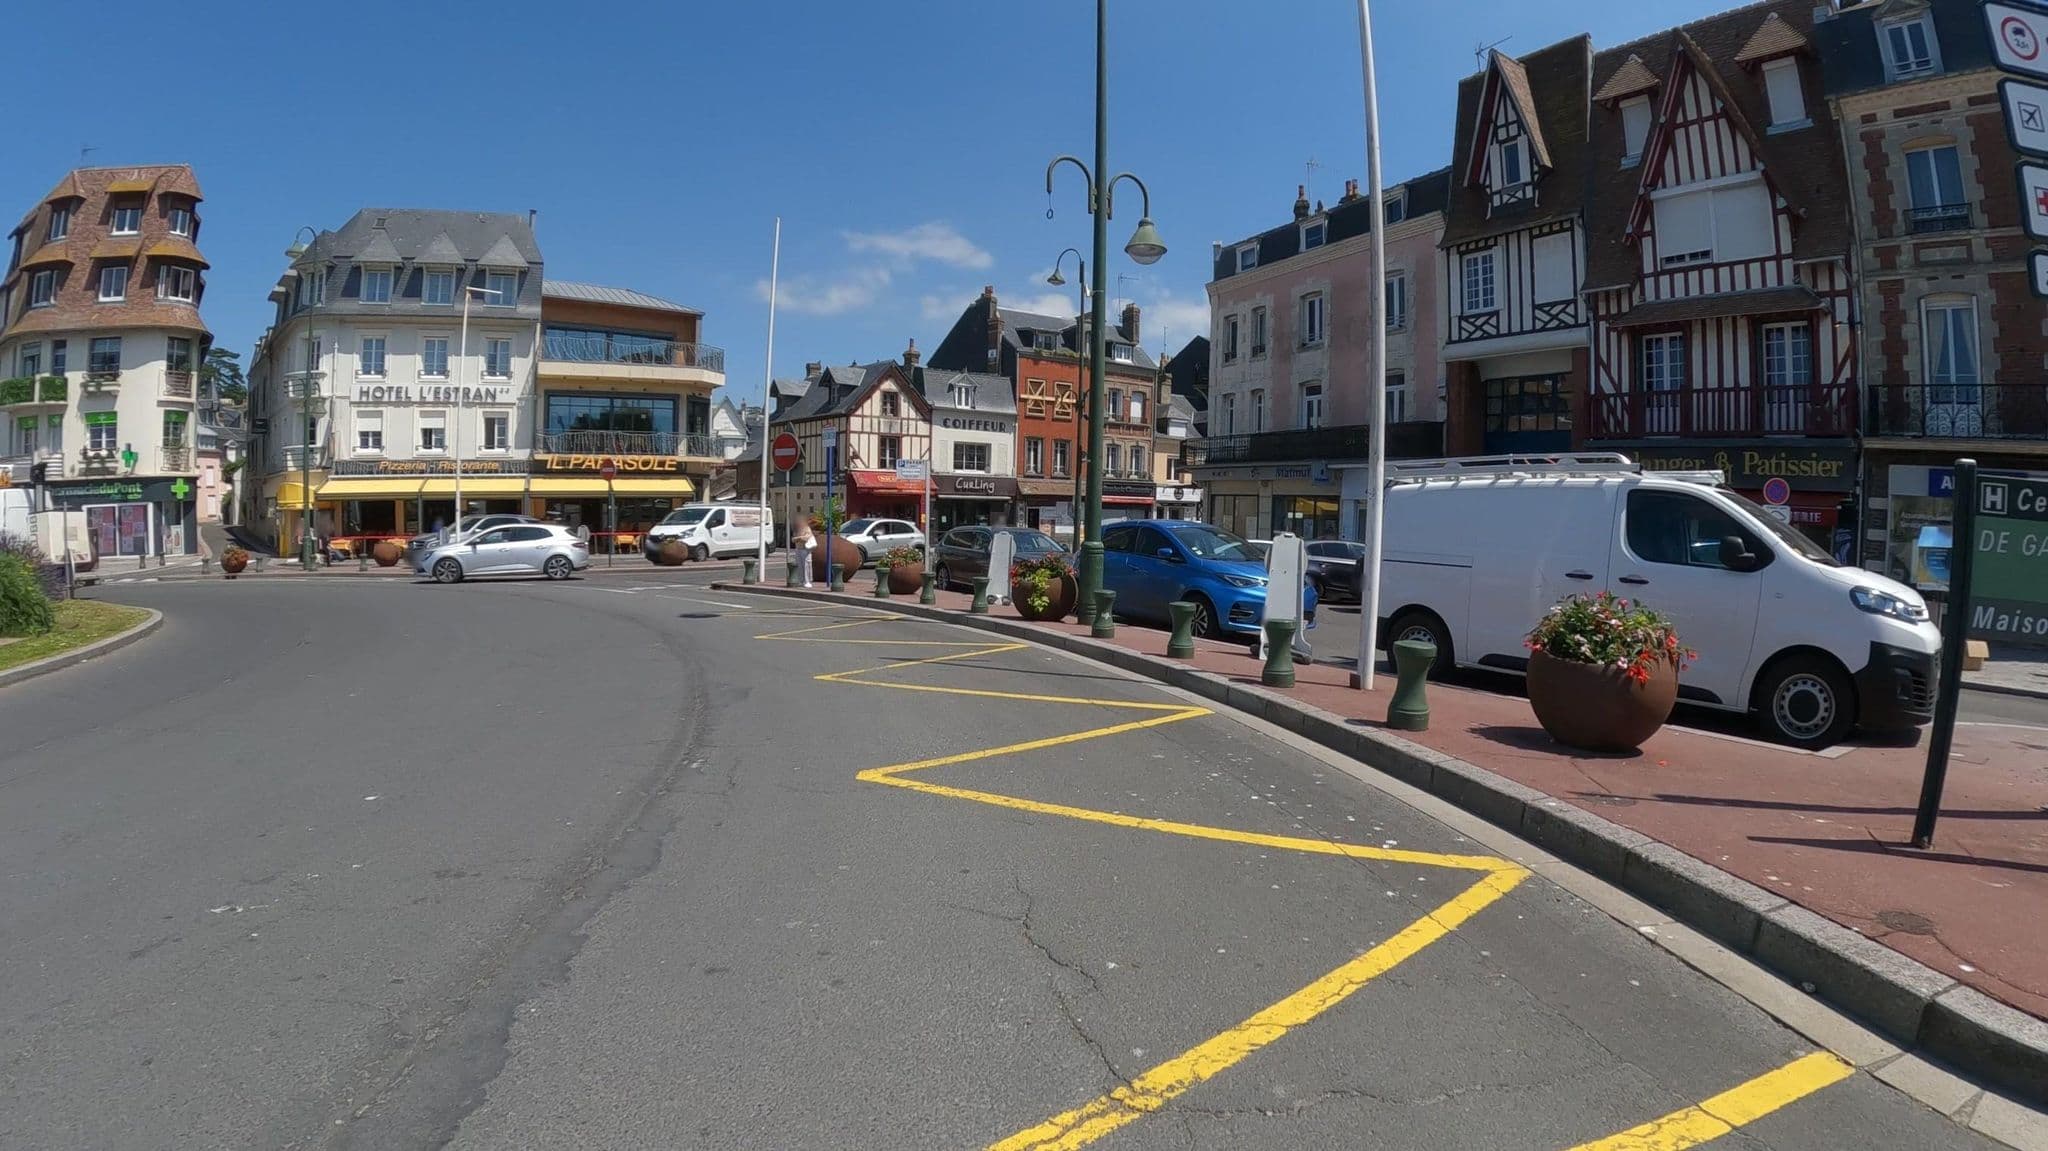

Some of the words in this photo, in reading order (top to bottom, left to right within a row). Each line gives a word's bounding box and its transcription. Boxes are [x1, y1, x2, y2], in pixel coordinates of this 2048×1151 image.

[359, 386, 411, 402] HOTEL
[942, 417, 1007, 433] COIFFEUR
[378, 461, 427, 471] Pizzeria
[438, 461, 500, 471] Risorante
[546, 455, 563, 470] IL
[1742, 451, 1844, 478] Patissier
[2016, 487, 2048, 513] Ce
[1979, 529, 2011, 554] DE
[1972, 605, 2048, 635] Maiso
